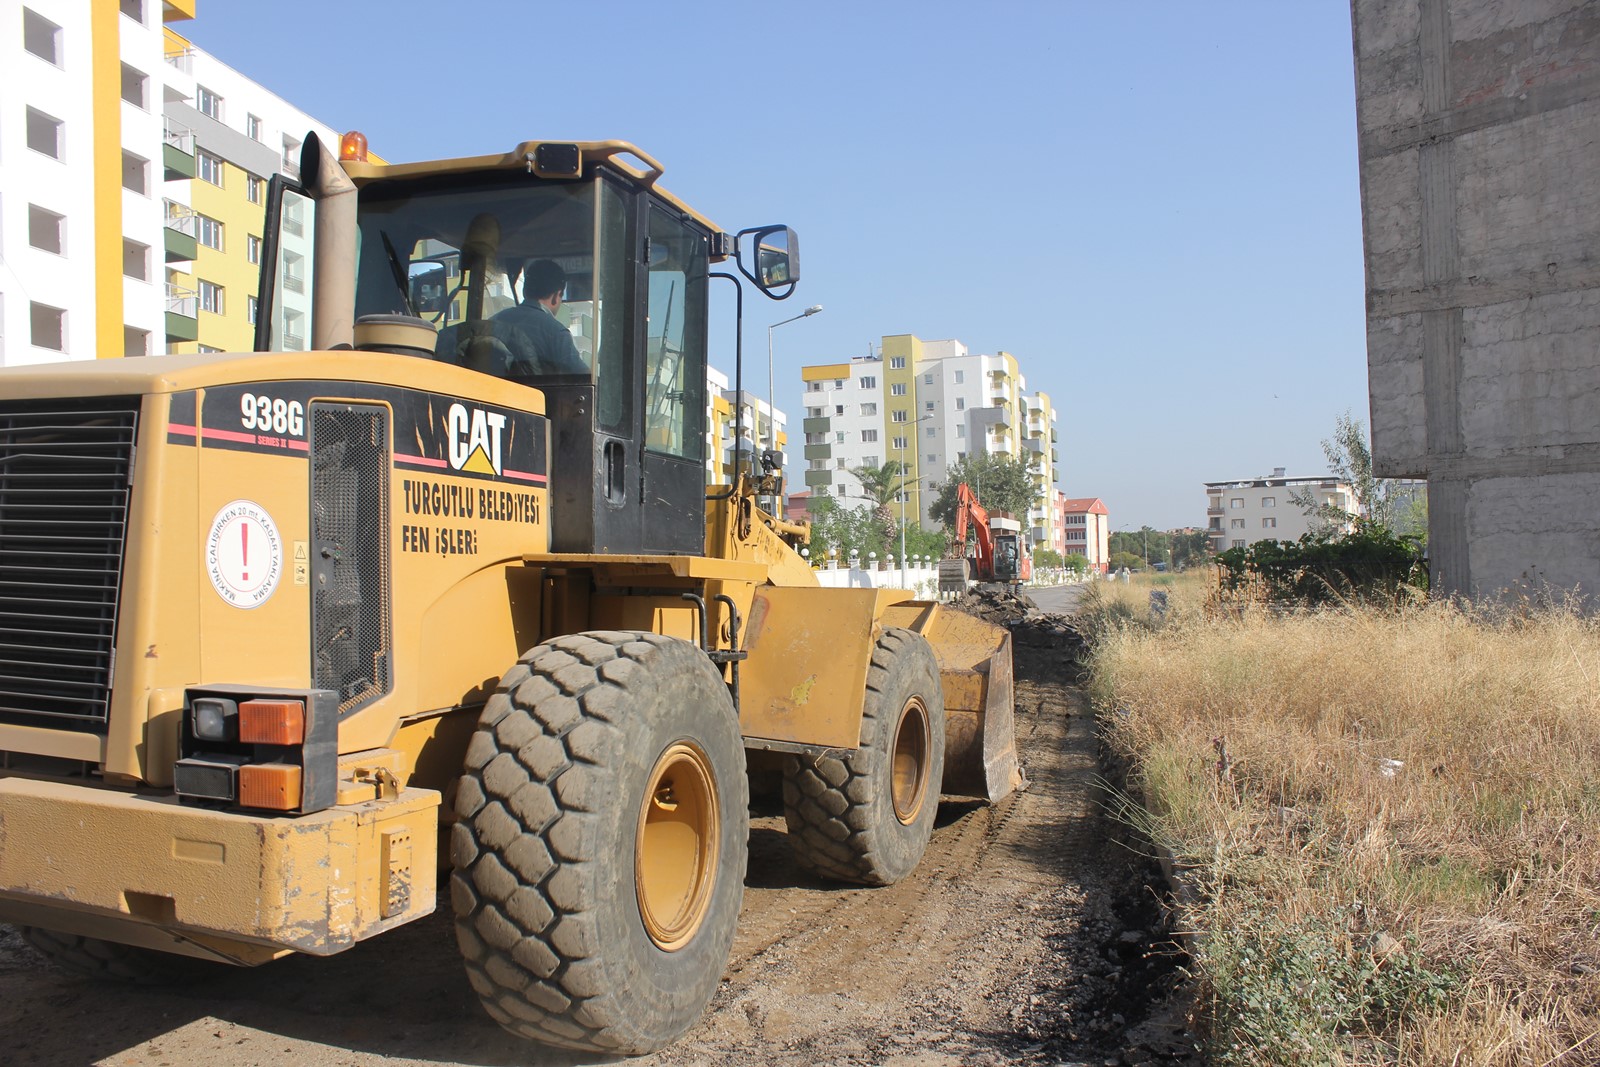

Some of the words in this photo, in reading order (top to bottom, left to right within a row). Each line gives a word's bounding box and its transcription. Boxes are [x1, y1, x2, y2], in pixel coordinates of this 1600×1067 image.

[241, 392, 304, 437] 938G
[257, 435, 280, 448] SERIES
[280, 438, 287, 448] II
[448, 403, 505, 476] CAT
[403, 479, 475, 519] TURGUTLU
[238, 507, 247, 516] 20
[260, 517, 278, 552] KADAR
[402, 525, 430, 553] FEN
